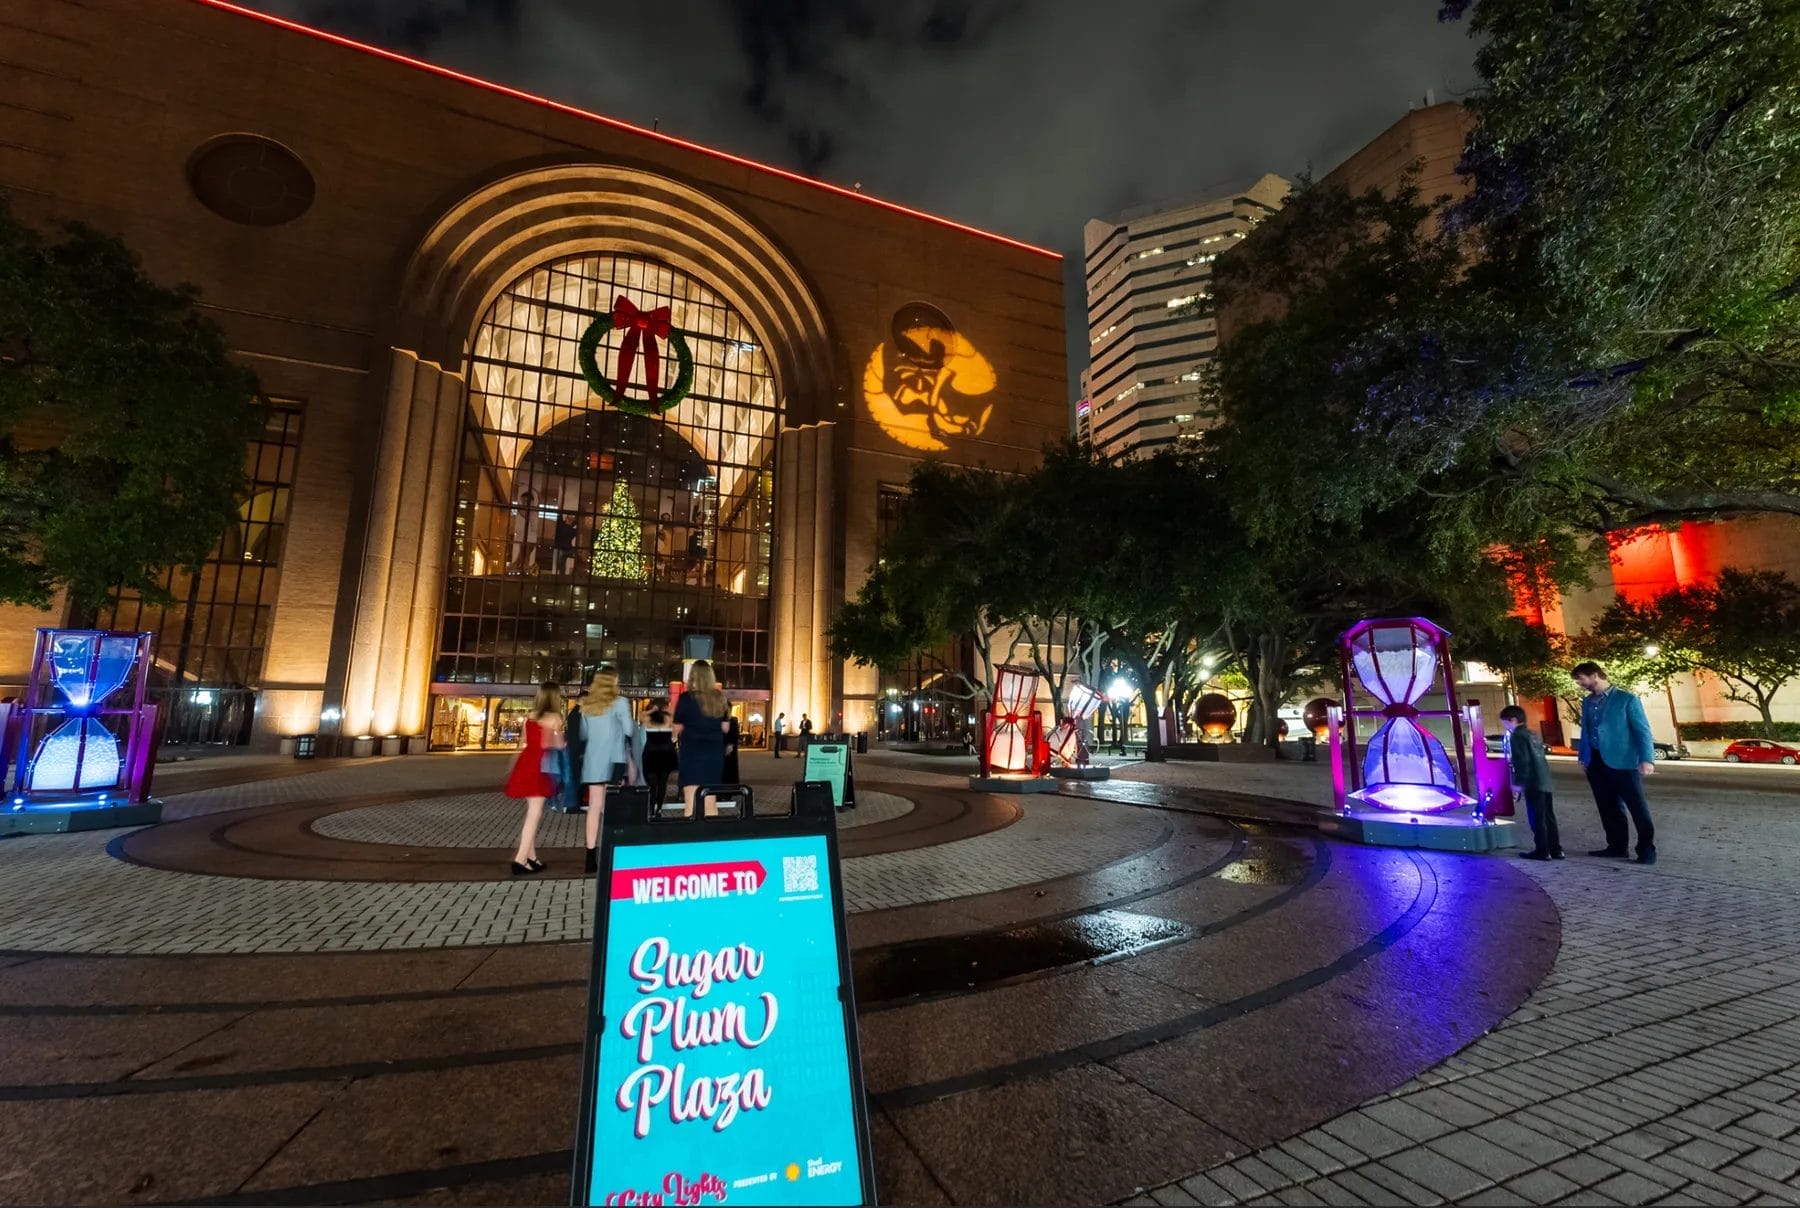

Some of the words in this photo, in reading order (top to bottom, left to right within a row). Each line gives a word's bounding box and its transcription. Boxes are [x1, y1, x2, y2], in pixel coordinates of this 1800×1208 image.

[632, 873, 728, 904] WELCOME
[733, 870, 757, 896] TO
[630, 937, 763, 997] Sugar
[621, 991, 778, 1063] Plum
[617, 1063, 771, 1138] Plaza
[663, 1172, 727, 1206] Lights
[808, 1161, 842, 1178] ENERGY
